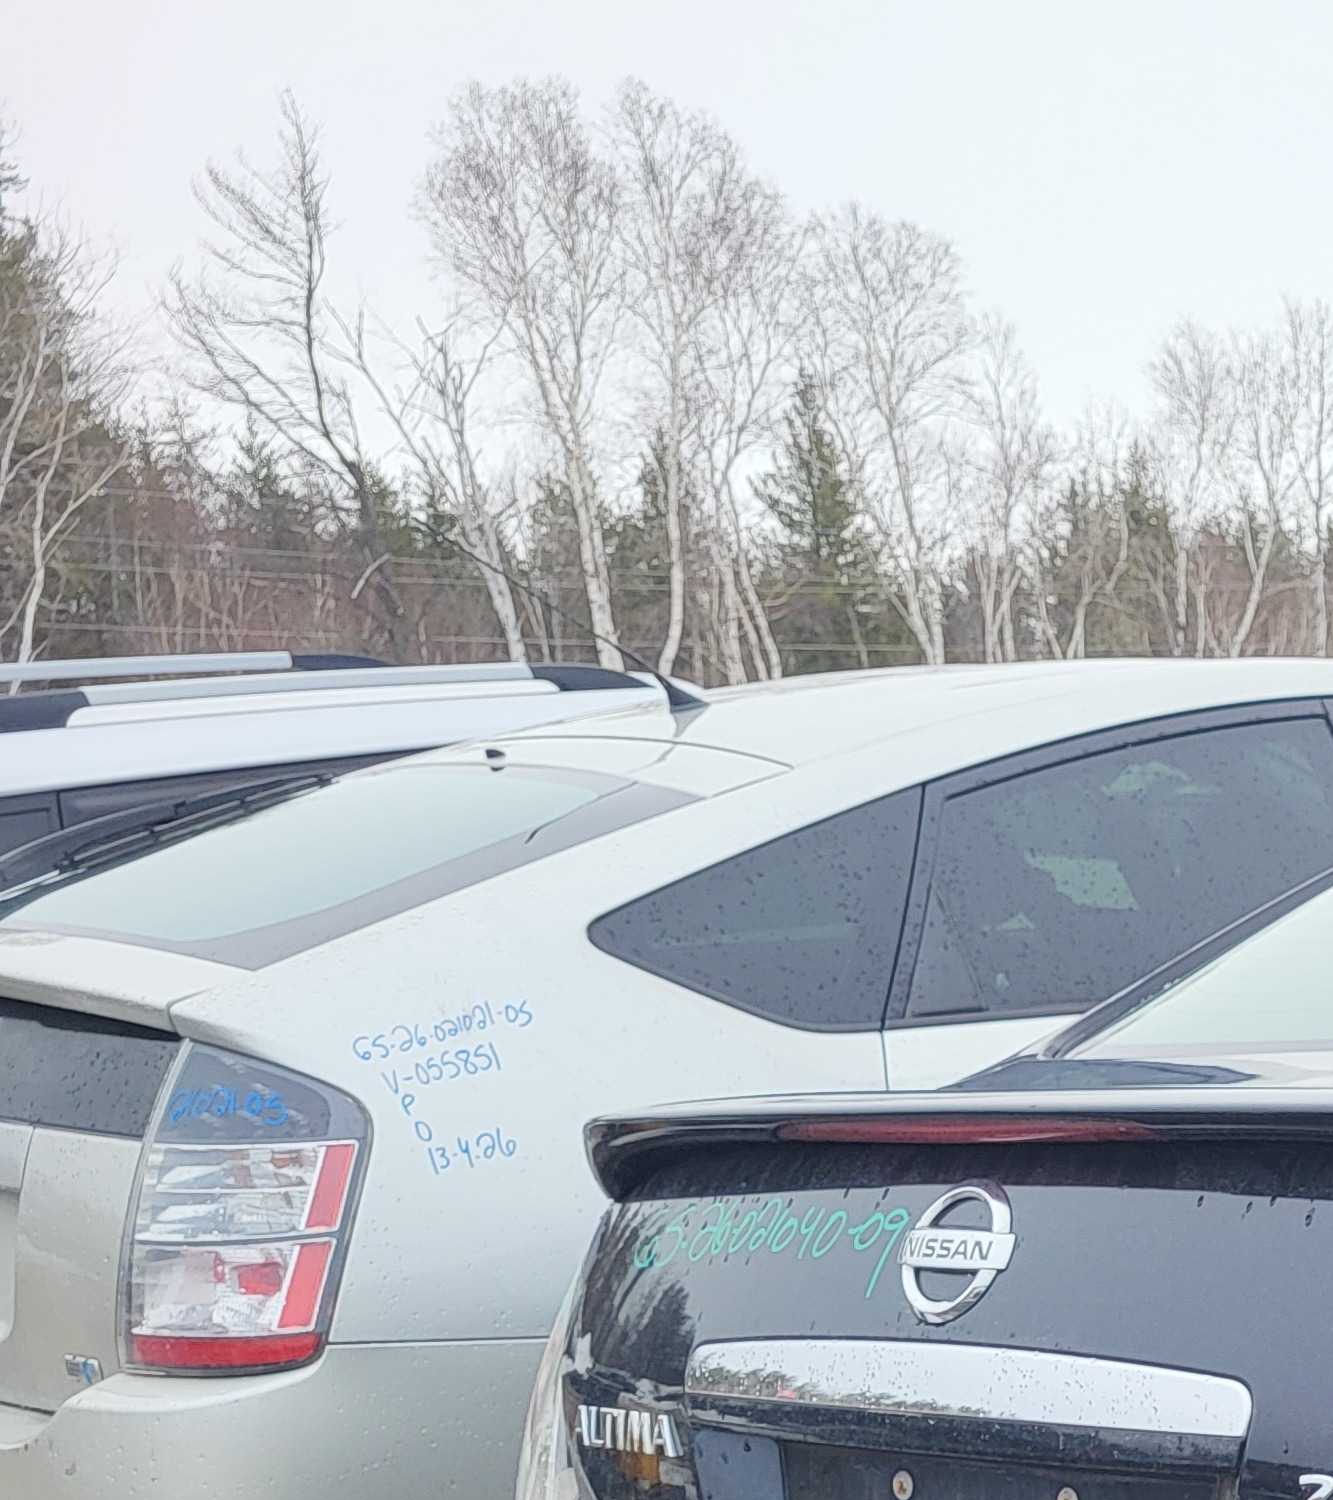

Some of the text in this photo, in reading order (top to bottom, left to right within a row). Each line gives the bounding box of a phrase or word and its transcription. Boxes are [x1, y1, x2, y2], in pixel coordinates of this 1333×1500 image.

[401, 1093, 416, 1116] P
[903, 1236, 994, 1261] NISSAN
[575, 1404, 685, 1458] ALTIMA
